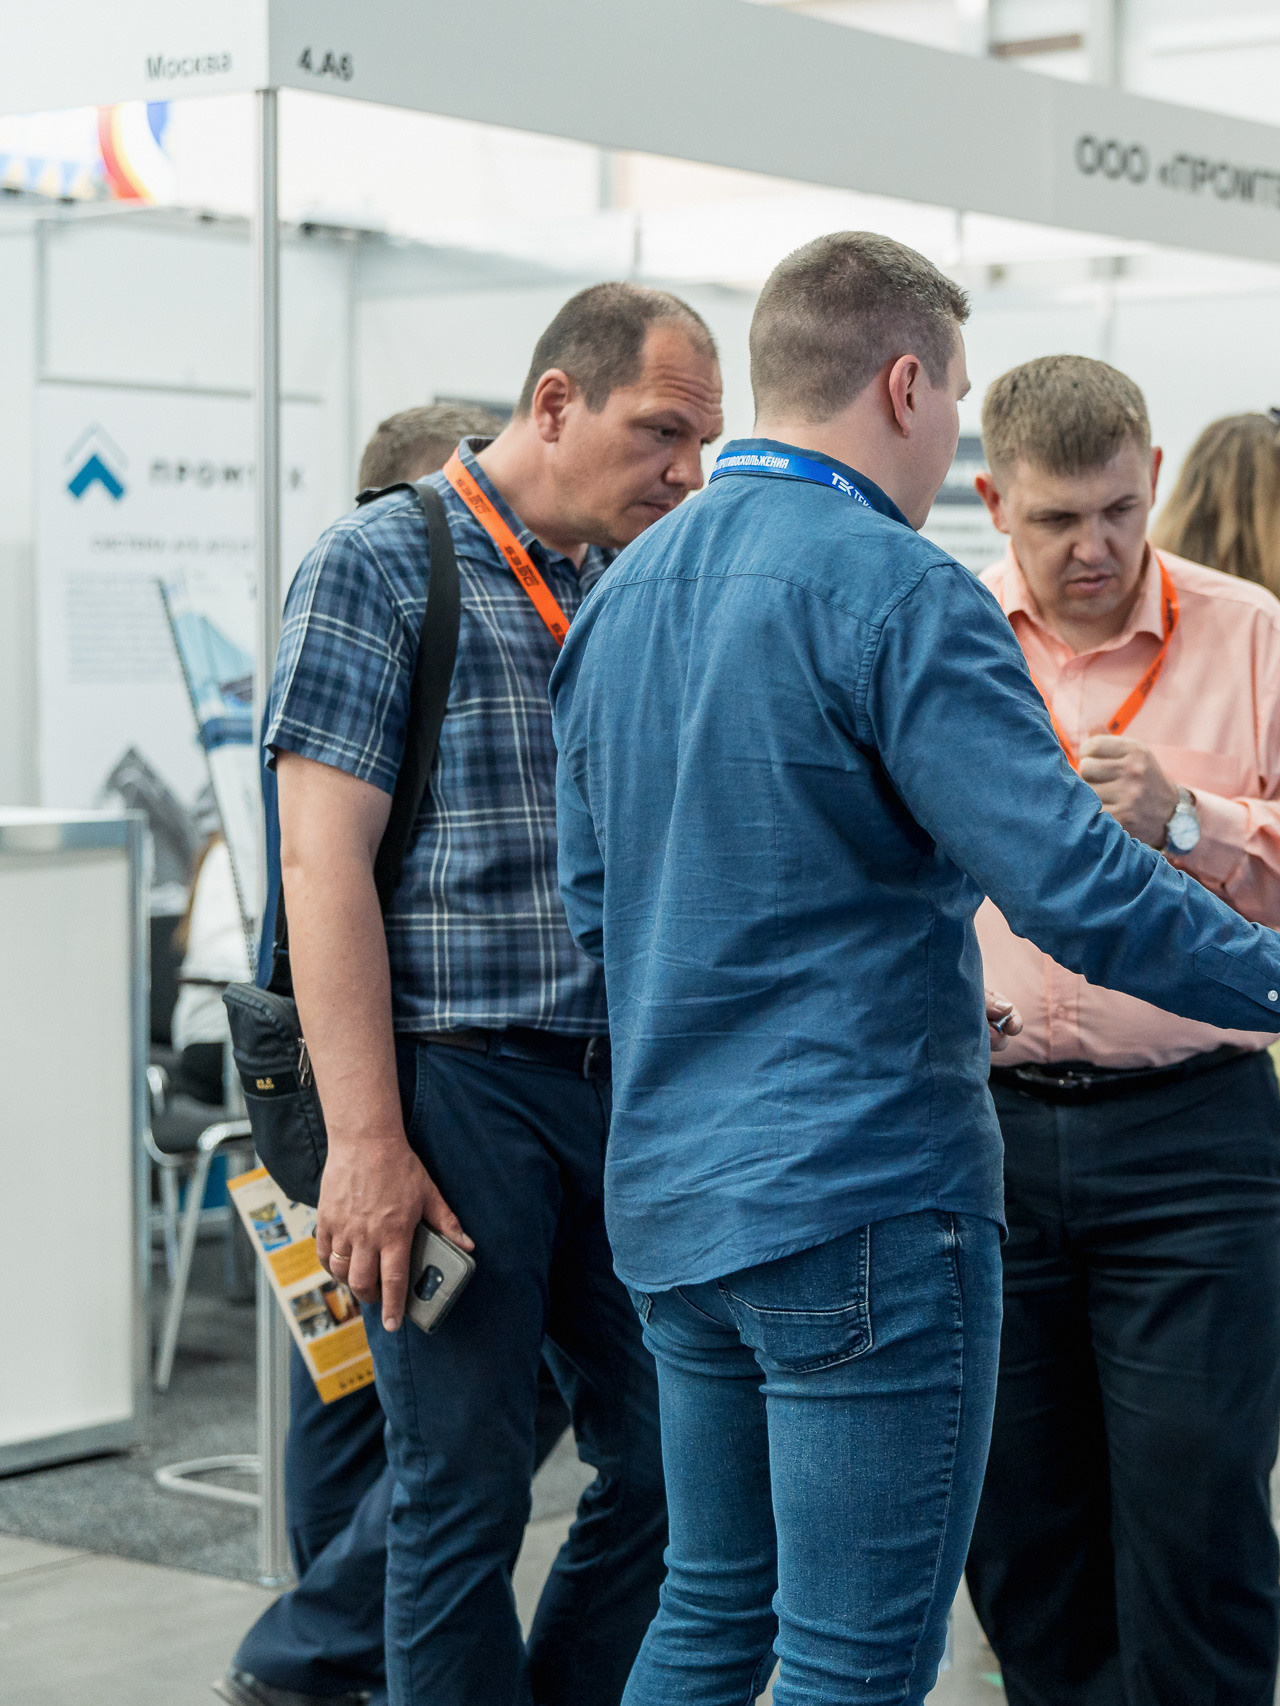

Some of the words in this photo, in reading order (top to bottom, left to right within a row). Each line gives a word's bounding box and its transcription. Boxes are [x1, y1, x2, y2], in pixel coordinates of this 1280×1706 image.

[147, 53, 232, 80] Москва
[1076, 134, 1148, 184] ООО
[150, 458, 303, 490] ПРОМХ
